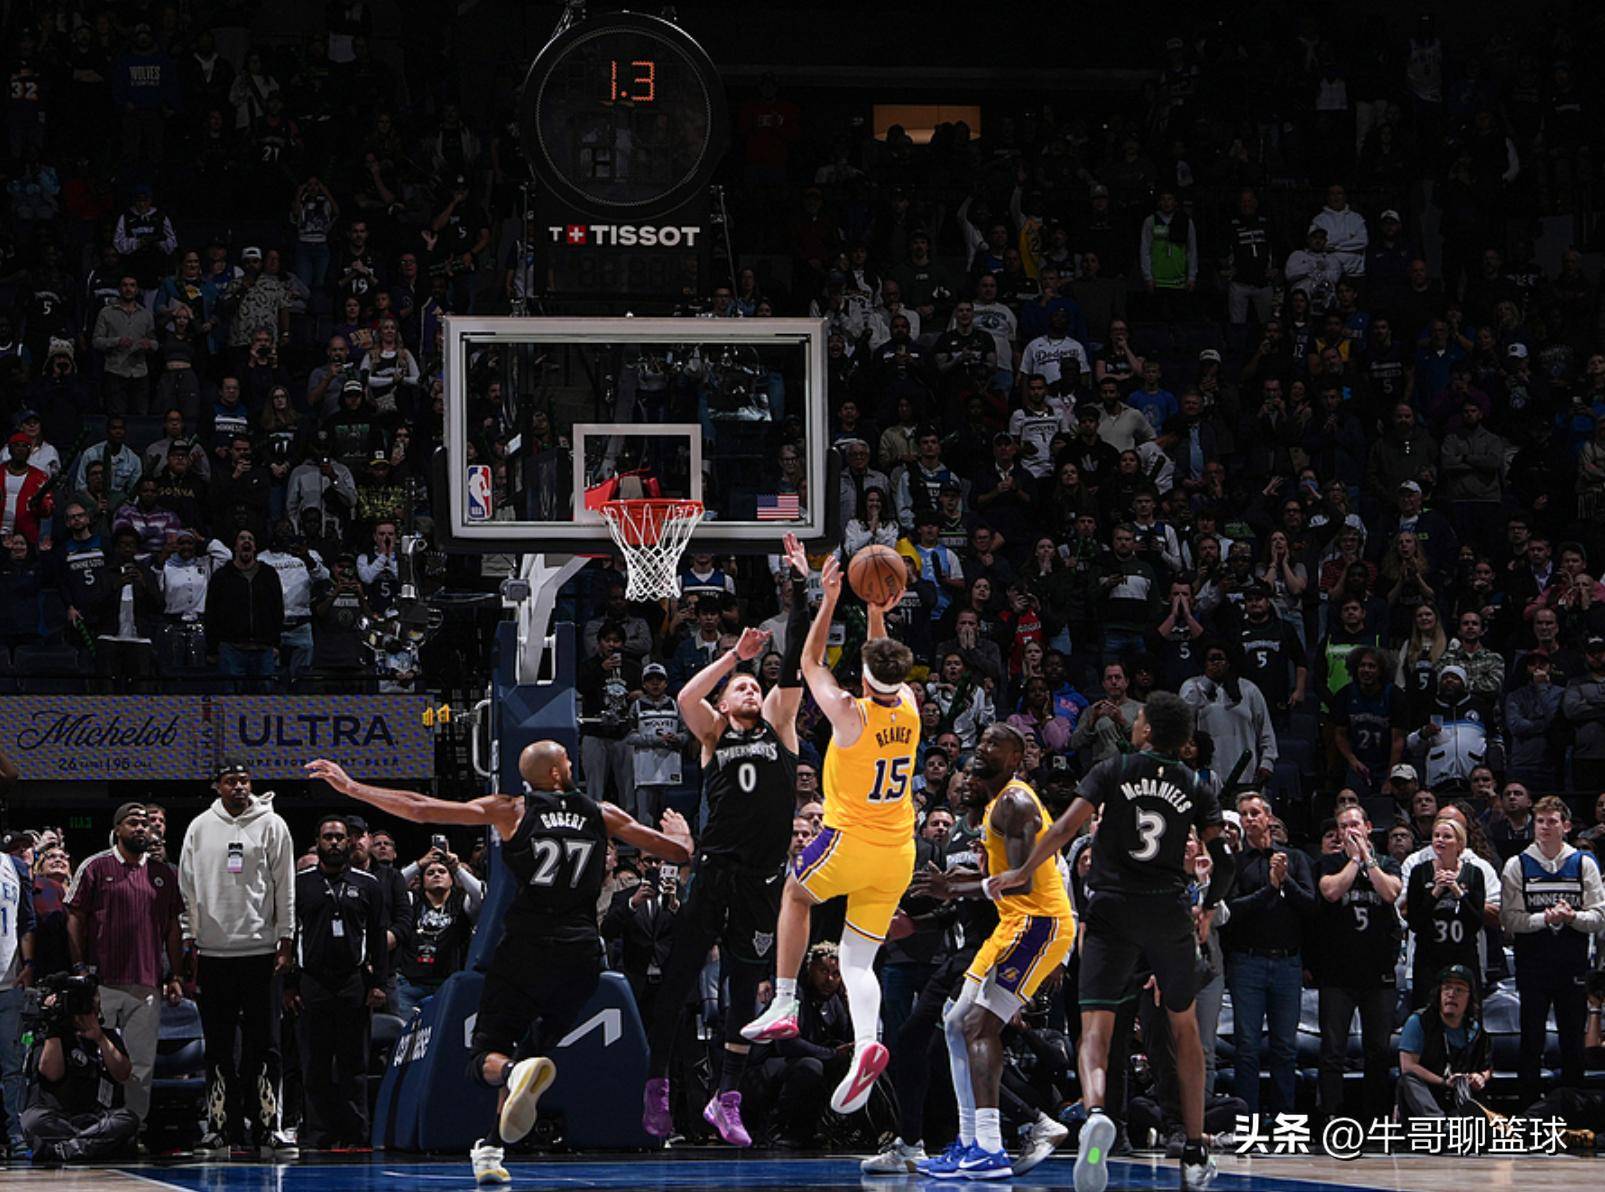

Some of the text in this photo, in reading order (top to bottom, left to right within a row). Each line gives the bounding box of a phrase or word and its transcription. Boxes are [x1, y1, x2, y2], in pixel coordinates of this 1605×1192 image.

[11, 81, 40, 101] 32
[611, 59, 655, 102] 1.3
[589, 225, 701, 246] TISSOT
[83, 569, 95, 585] 5
[380, 582, 391, 598] 5
[1180, 642, 1191, 660] 5
[1256, 651, 1268, 669] 5
[1418, 672, 1429, 690] 5
[17, 710, 179, 750] Michelob
[239, 715, 394, 746] ULTRA
[876, 727, 912, 748] REAVES
[1357, 729, 1382, 749] 21
[739, 763, 757, 792] 0
[868, 757, 911, 803] 15
[540, 811, 588, 831] GOBERT
[1128, 805, 1167, 861] 3
[530, 836, 598, 889] 27
[1354, 905, 1369, 932] 5
[1434, 919, 1464, 943] 30
